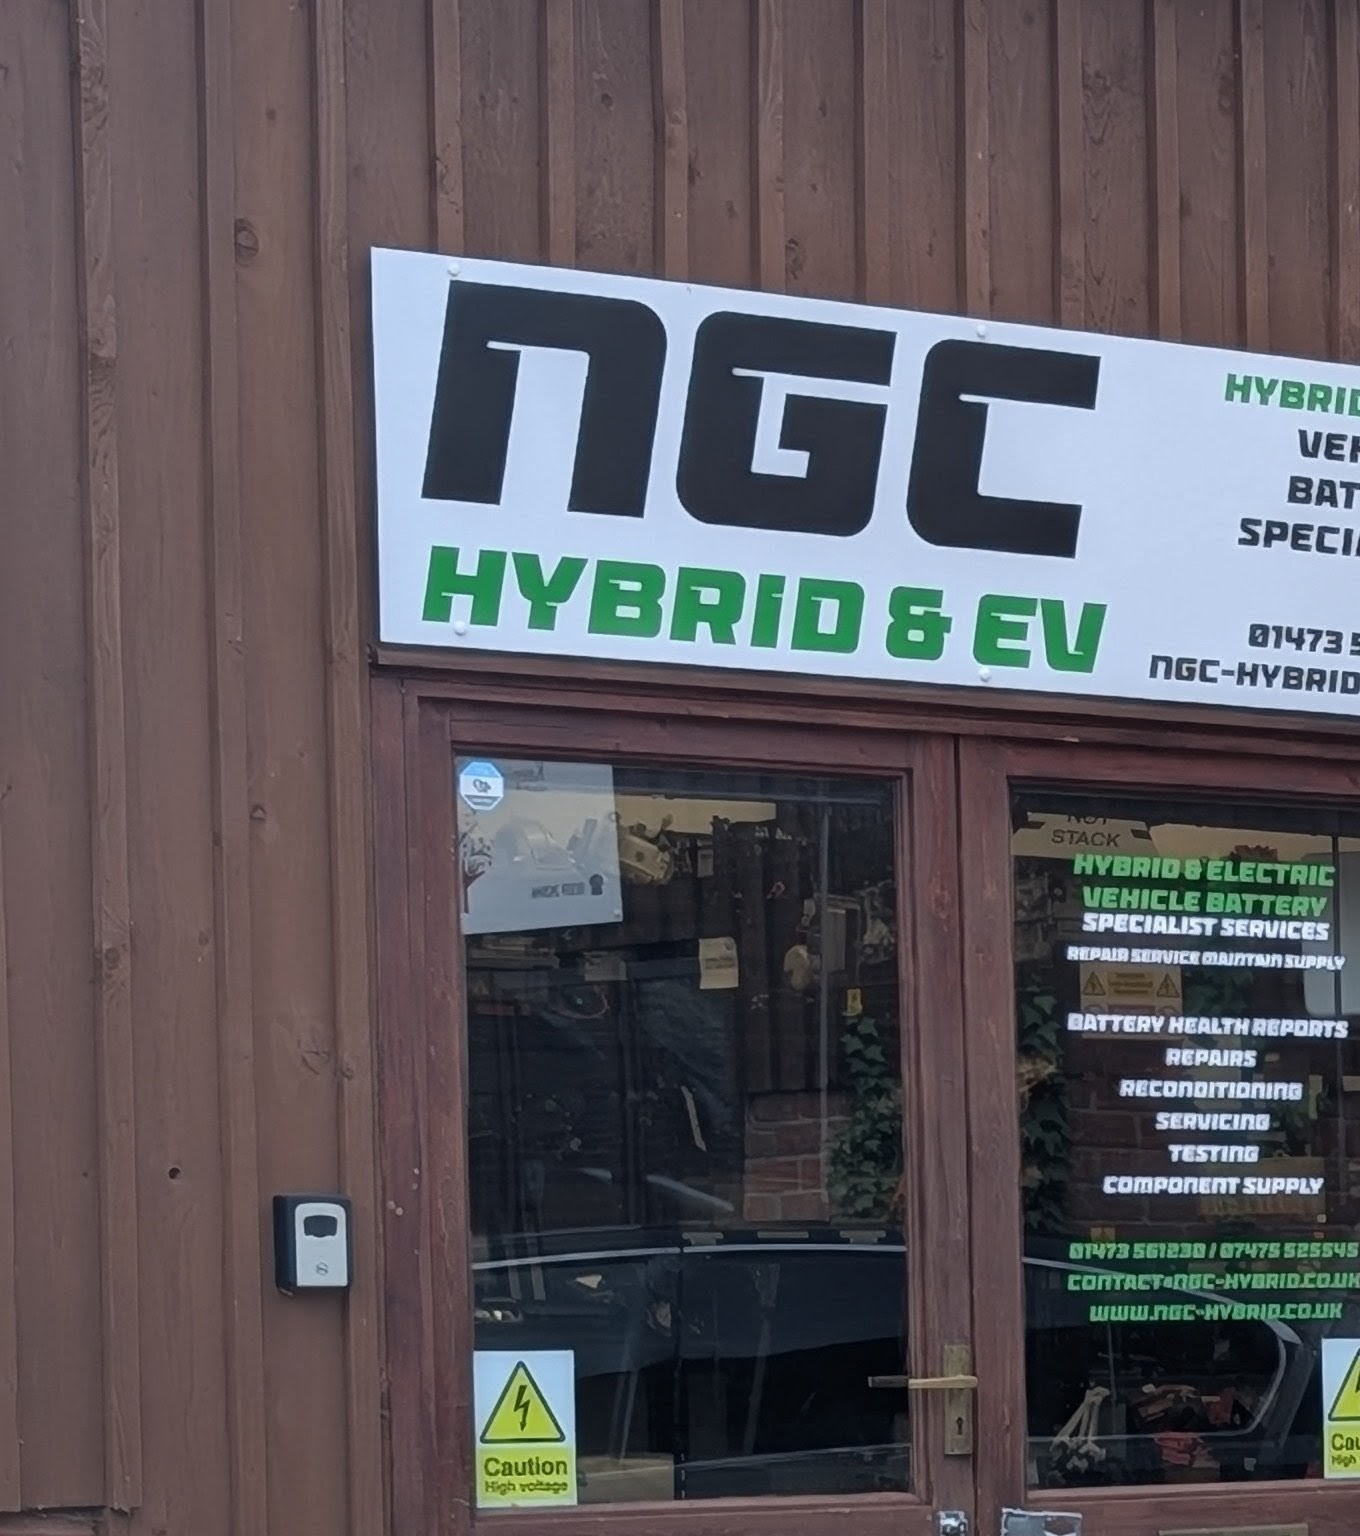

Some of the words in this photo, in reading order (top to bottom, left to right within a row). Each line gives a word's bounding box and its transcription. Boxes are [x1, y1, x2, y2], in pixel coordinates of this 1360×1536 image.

[421, 280, 1101, 559] NGC
[422, 546, 864, 653] HYBRID
[886, 586, 952, 660] &
[973, 594, 1107, 673] EV
[1249, 624, 1343, 654] 01473
[1051, 828, 1120, 847] STACK
[1073, 853, 1181, 879] HYBRID
[1185, 860, 1201, 880] &
[1206, 860, 1335, 887] ELECTRIC
[1082, 885, 1200, 912] VEHICLE
[1205, 892, 1327, 917] BATTERY
[1082, 912, 1219, 936] SPECIALIST
[1220, 918, 1330, 940] SERVICES
[1067, 945, 1129, 962] REPAIR
[1130, 948, 1200, 965] SERVICE
[1201, 951, 1283, 968] MAINTAIN
[1284, 955, 1346, 970] SUPPLY
[1067, 1012, 1165, 1033] BATTERY
[1167, 1015, 1250, 1035] HEALTH
[1252, 1018, 1350, 1038] REPORTS
[1165, 1047, 1257, 1067] REPAIRS
[1119, 1079, 1303, 1100] RECONDITIONING
[1155, 1112, 1270, 1130] SERVICING
[1168, 1144, 1259, 1162] TESTING
[1103, 1176, 1240, 1194] COMPONENT
[1242, 1177, 1324, 1194] SUPPLY
[1069, 1243, 1129, 1259] 01473
[1133, 1243, 1206, 1259] 561230
[484, 1456, 568, 1476] Caution
[485, 1481, 516, 1495] High
